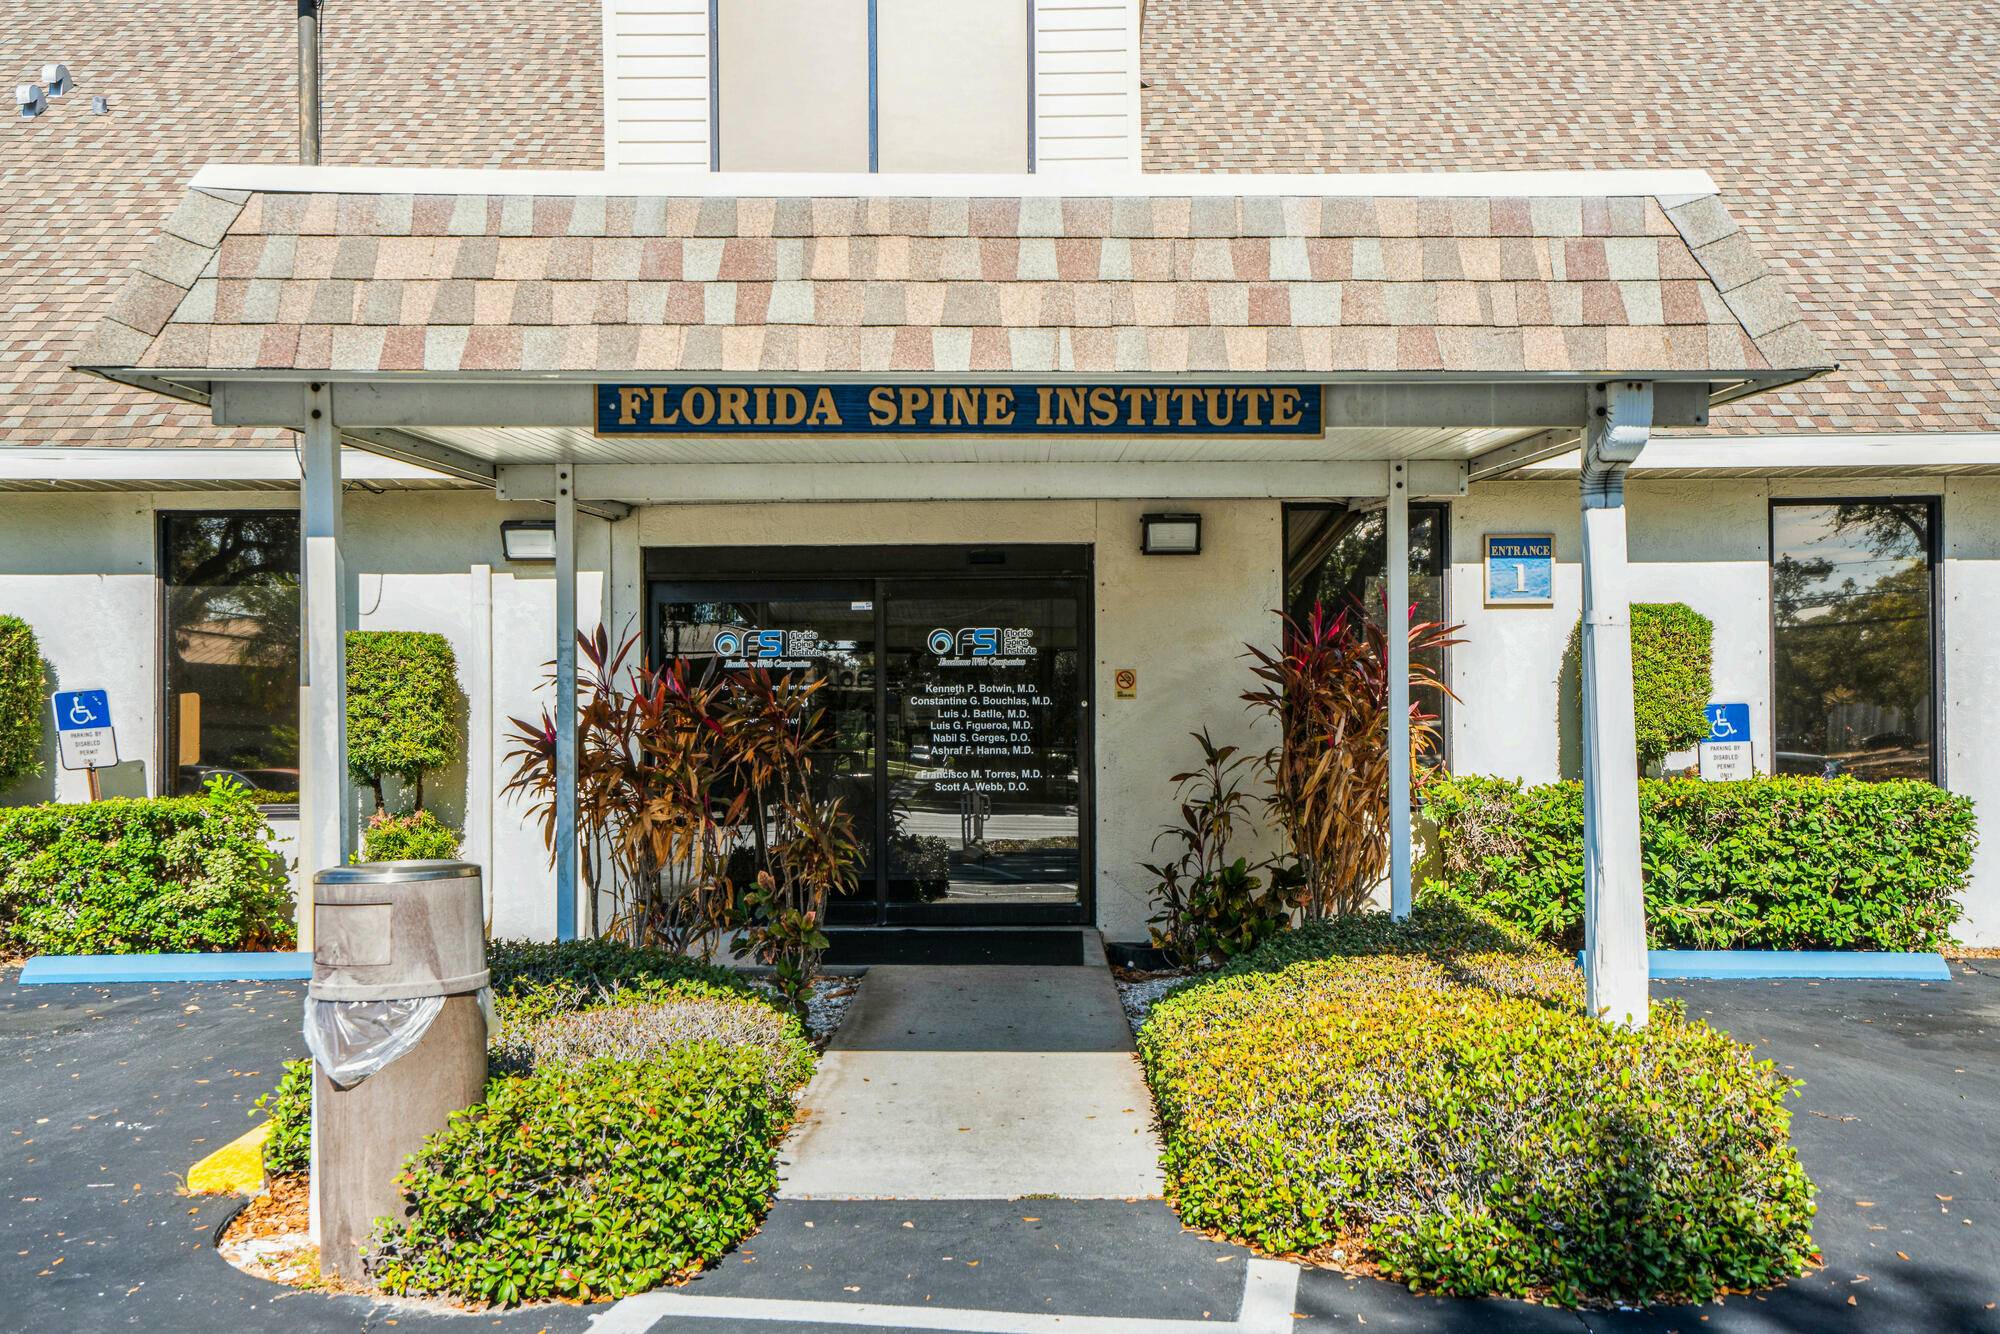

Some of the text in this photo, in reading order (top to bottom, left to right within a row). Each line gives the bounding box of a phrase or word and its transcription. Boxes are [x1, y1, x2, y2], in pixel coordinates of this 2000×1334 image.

[617, 386, 1303, 426] FLORIDA SPINE INSTITUTE
[1491, 546, 1550, 556] ENTRANCE
[1512, 563, 1529, 592] 1
[790, 631, 818, 640] Florida
[1004, 628, 1033, 637] Florida
[742, 630, 788, 657] FSI
[790, 641, 814, 649] Spine
[956, 628, 1002, 655] FSI
[1004, 638, 1029, 647] Spine
[790, 649, 824, 657] Institute
[1004, 646, 1037, 655] Institute
[926, 685, 1038, 694] Kenneth P. Botwin, M.D.
[911, 697, 1053, 706] Constantine G. Bouchlas, M.D.
[938, 710, 958, 718] Luis
[961, 710, 971, 718] J.
[1007, 710, 1029, 718] M.D.
[930, 722, 1033, 732] Luis G. Figueroa, M.D.
[934, 734, 1031, 744] Nabil S. Gerges, D.O.
[931, 746, 963, 755] Ashraf
[977, 747, 1010, 755] Hanna,
[921, 770, 968, 779] Francisco
[985, 771, 1019, 780] Torres,
[935, 783, 1029, 792] Scott A. Webb, D.O.
